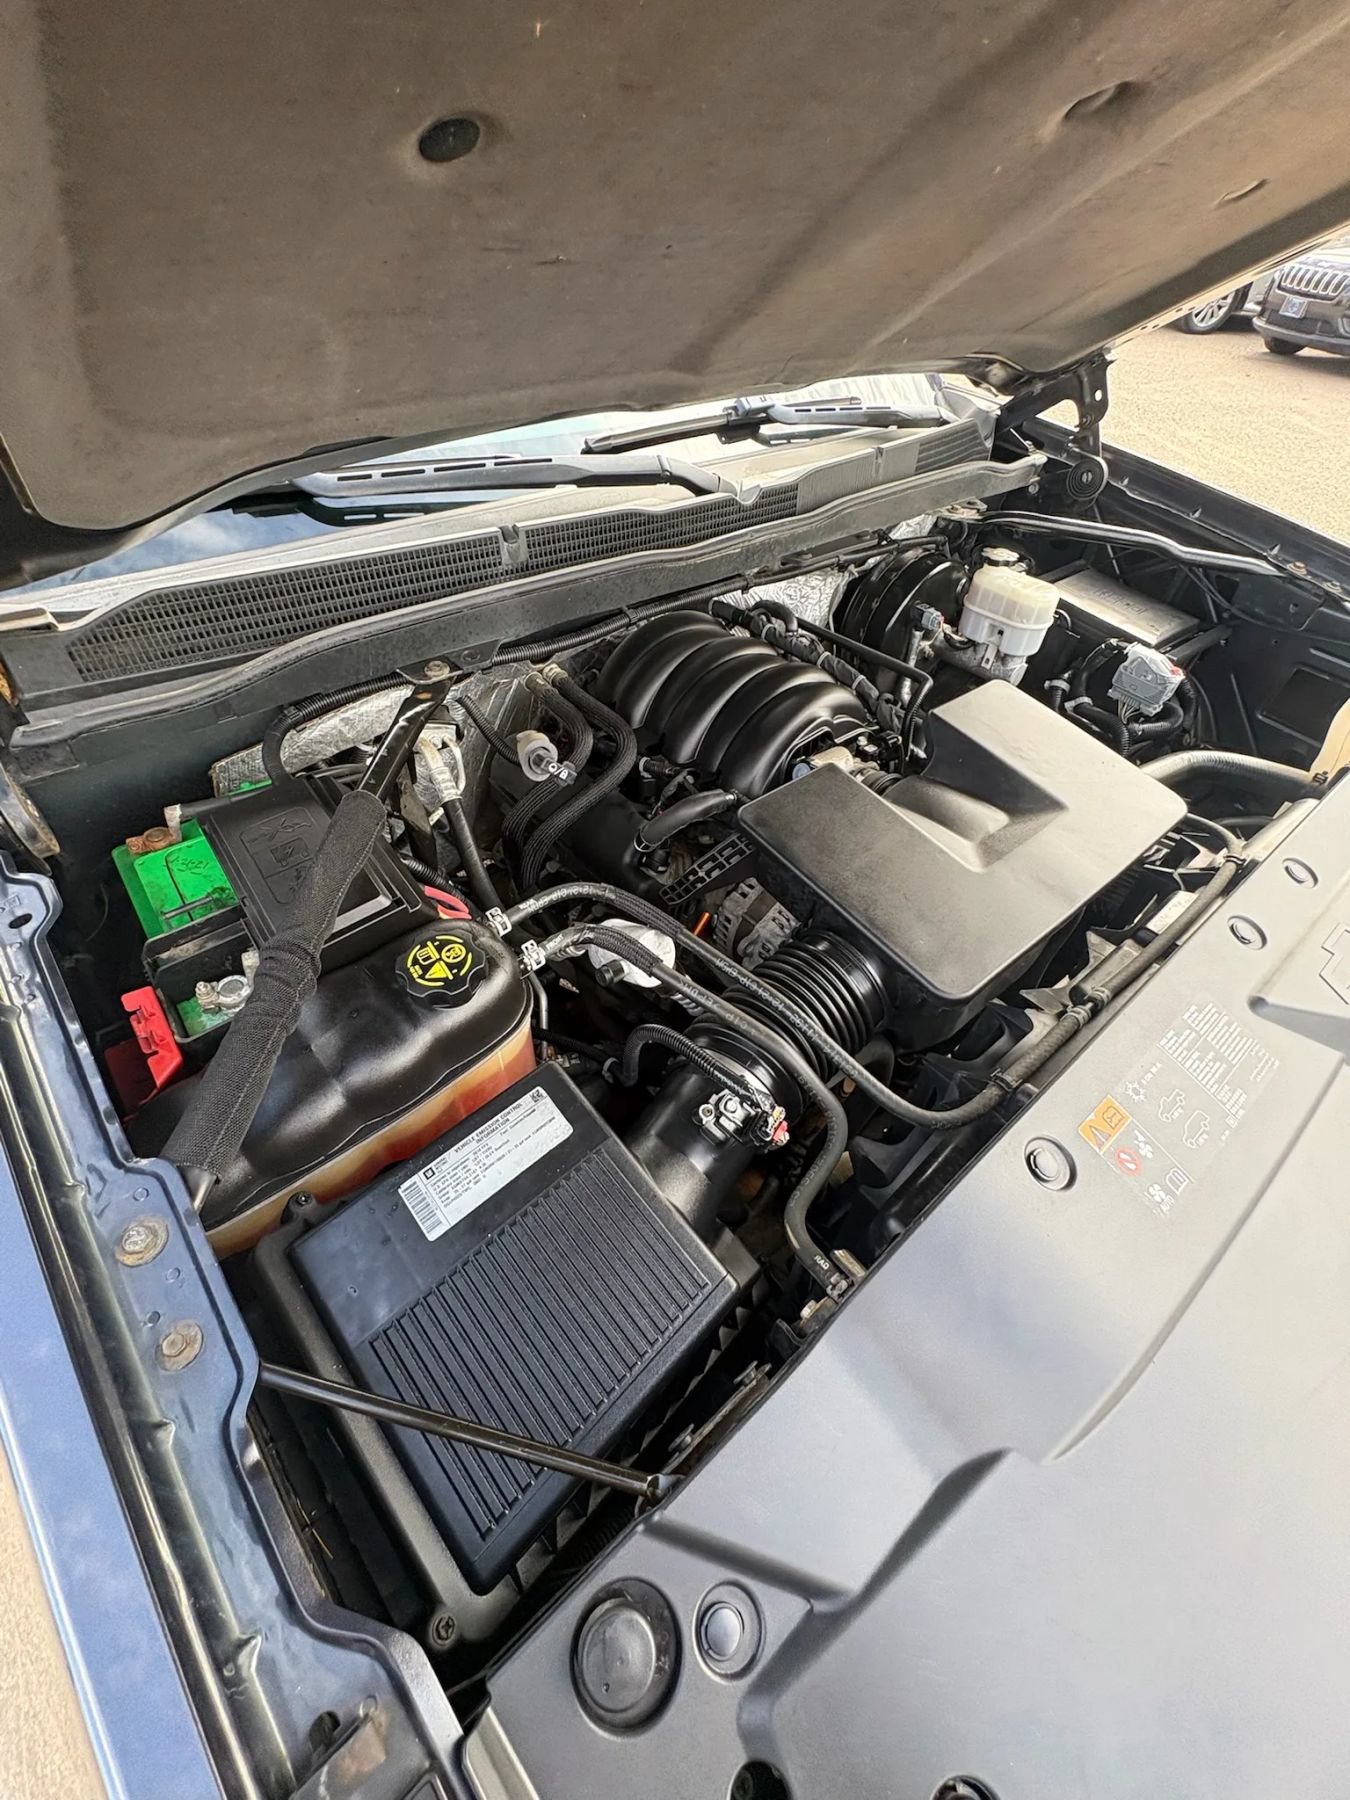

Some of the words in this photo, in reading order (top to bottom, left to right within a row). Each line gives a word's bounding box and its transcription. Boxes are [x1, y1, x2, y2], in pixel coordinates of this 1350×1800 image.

[454, 1136, 475, 1153] VEHICLE
[476, 1118, 500, 1136] EMISSION
[500, 1103, 522, 1120] CONTROL
[476, 1118, 510, 1144] INFORMATION
